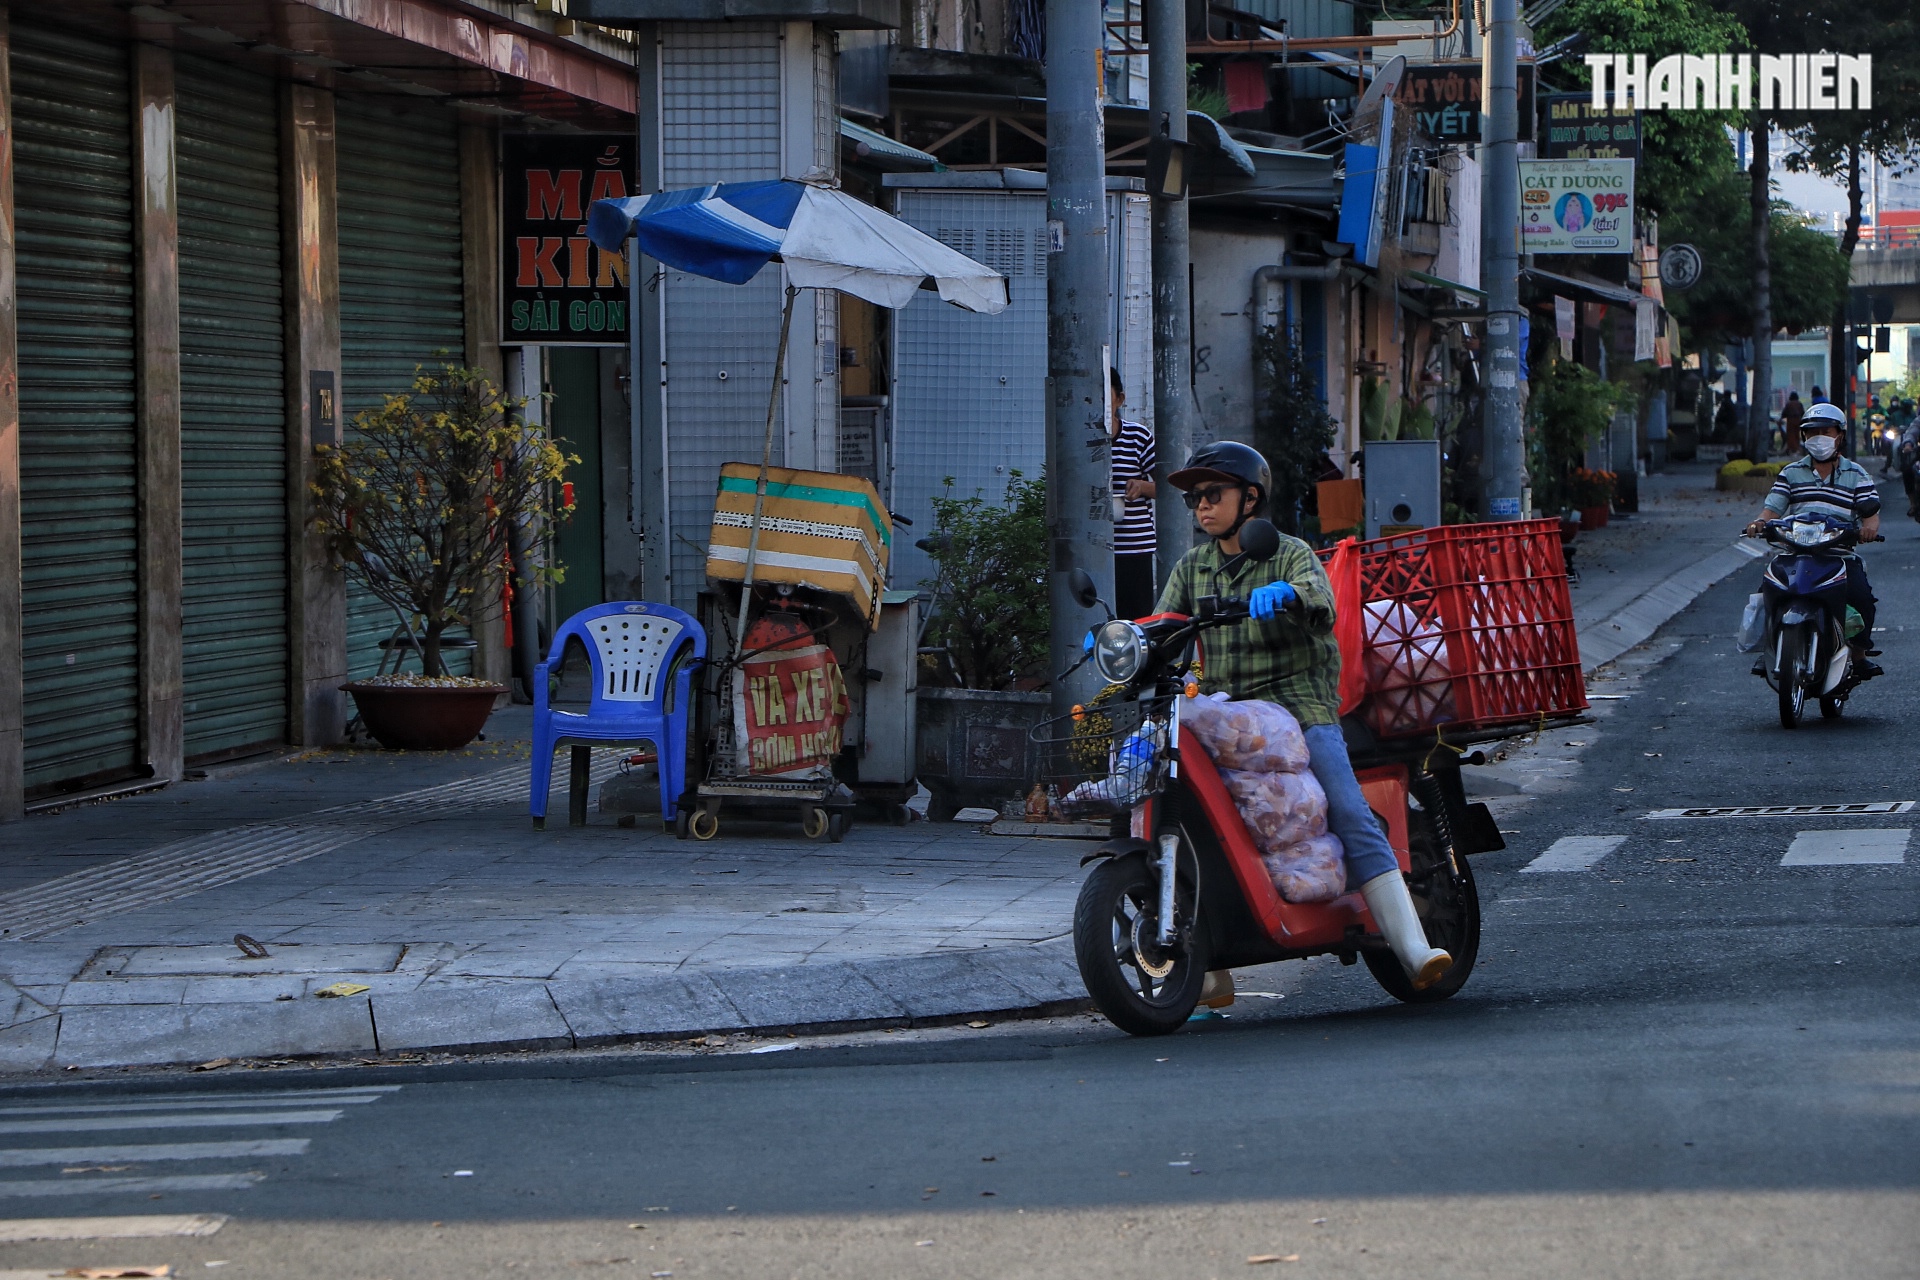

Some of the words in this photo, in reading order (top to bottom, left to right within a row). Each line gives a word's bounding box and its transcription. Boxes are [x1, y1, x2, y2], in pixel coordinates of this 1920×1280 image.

[1551, 100, 1579, 119] BÁN
[1551, 127, 1580, 142] MAY
[1613, 120, 1636, 140] GIẢ
[526, 146, 629, 220] MẮ
[1525, 174, 1556, 188] CÁT
[1593, 193, 1628, 212] 99K
[516, 225, 630, 287] KÍN
[511, 292, 560, 332] SÀI
[569, 292, 625, 332] GÒN
[750, 664, 788, 726] VÁ
[791, 668, 826, 723] XE
[752, 733, 796, 772] BƠM
